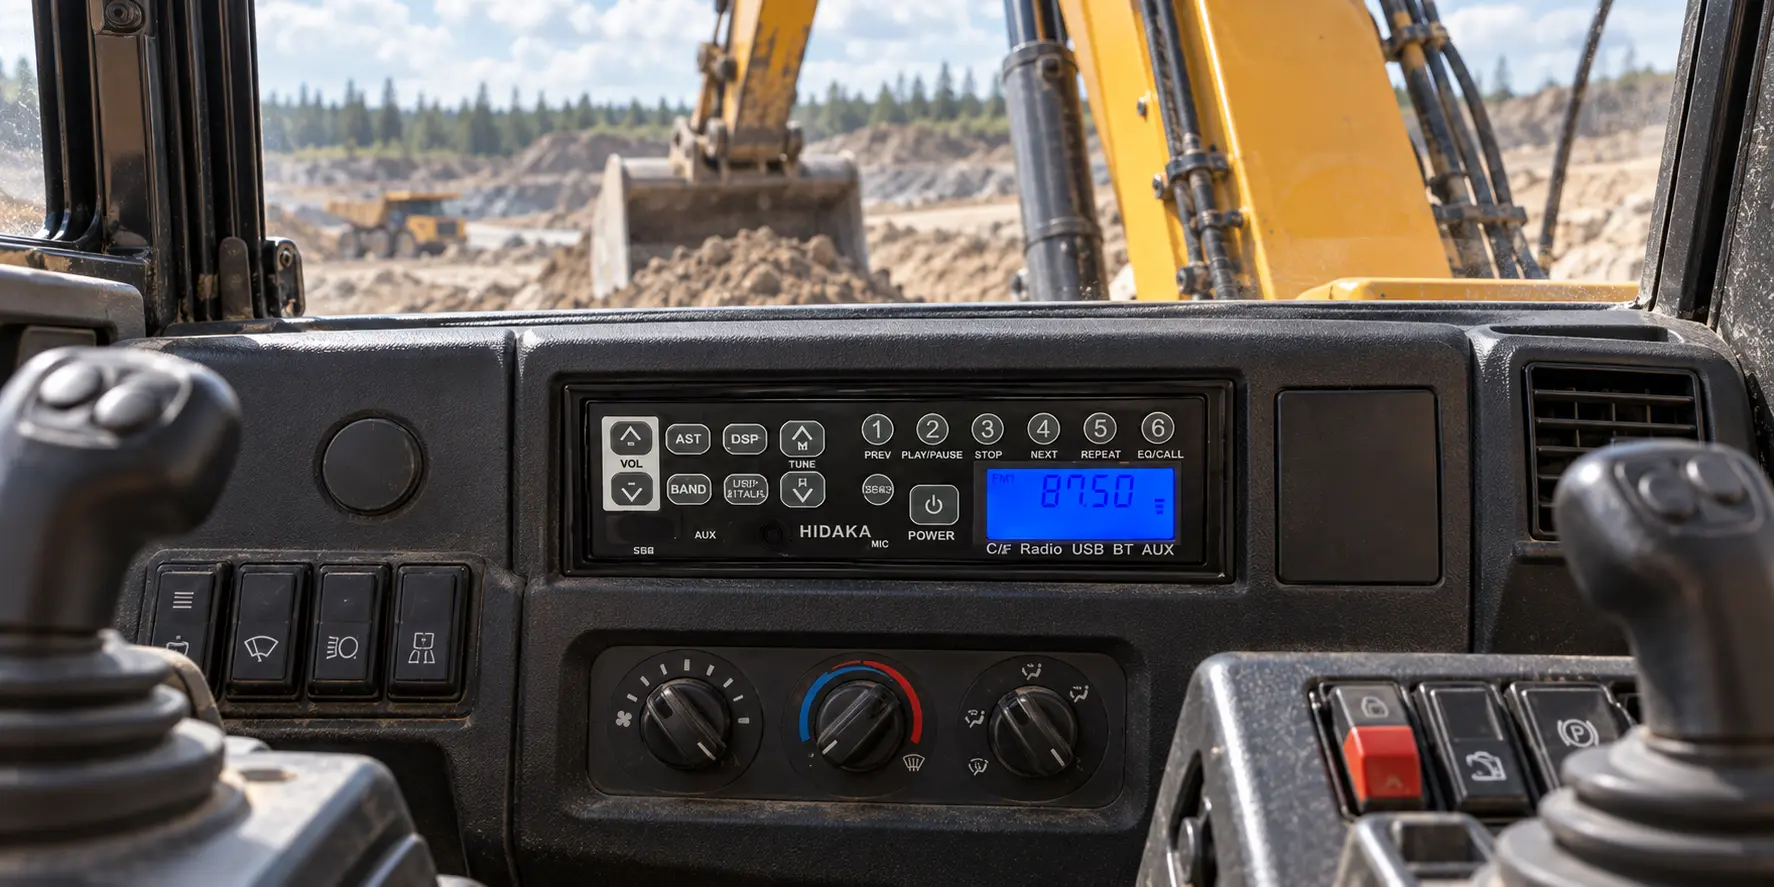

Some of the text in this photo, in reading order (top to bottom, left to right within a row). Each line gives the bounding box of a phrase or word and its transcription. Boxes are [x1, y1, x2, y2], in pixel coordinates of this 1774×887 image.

[872, 419, 881, 439] 1
[926, 419, 940, 439] 2
[981, 419, 994, 439] 3
[1036, 419, 1051, 438] 4
[1094, 419, 1108, 438] 5
[1151, 418, 1165, 438] 6
[675, 433, 702, 444] AST
[731, 433, 759, 444] DSP
[864, 450, 892, 459] PREV
[901, 450, 963, 459] PLAY/PAUSE
[974, 450, 1003, 459] STOP
[1030, 450, 1058, 459] NEXT
[1081, 450, 1122, 459] REPEAT
[1137, 450, 1184, 459] EQ/CALL
[620, 459, 643, 469] VOL
[788, 460, 816, 469] TUNE
[991, 473, 1015, 484] FM1
[670, 484, 707, 495] BAND
[1041, 474, 1135, 508] 87.50
[694, 530, 717, 540] AUX
[799, 524, 872, 539] HIDAKA
[908, 530, 955, 541] POWER
[871, 540, 889, 549] MIC
[1020, 543, 1063, 556] Radio
[1072, 543, 1105, 556] USB
[1113, 543, 1134, 556] BT
[1141, 543, 1175, 556] AUX
